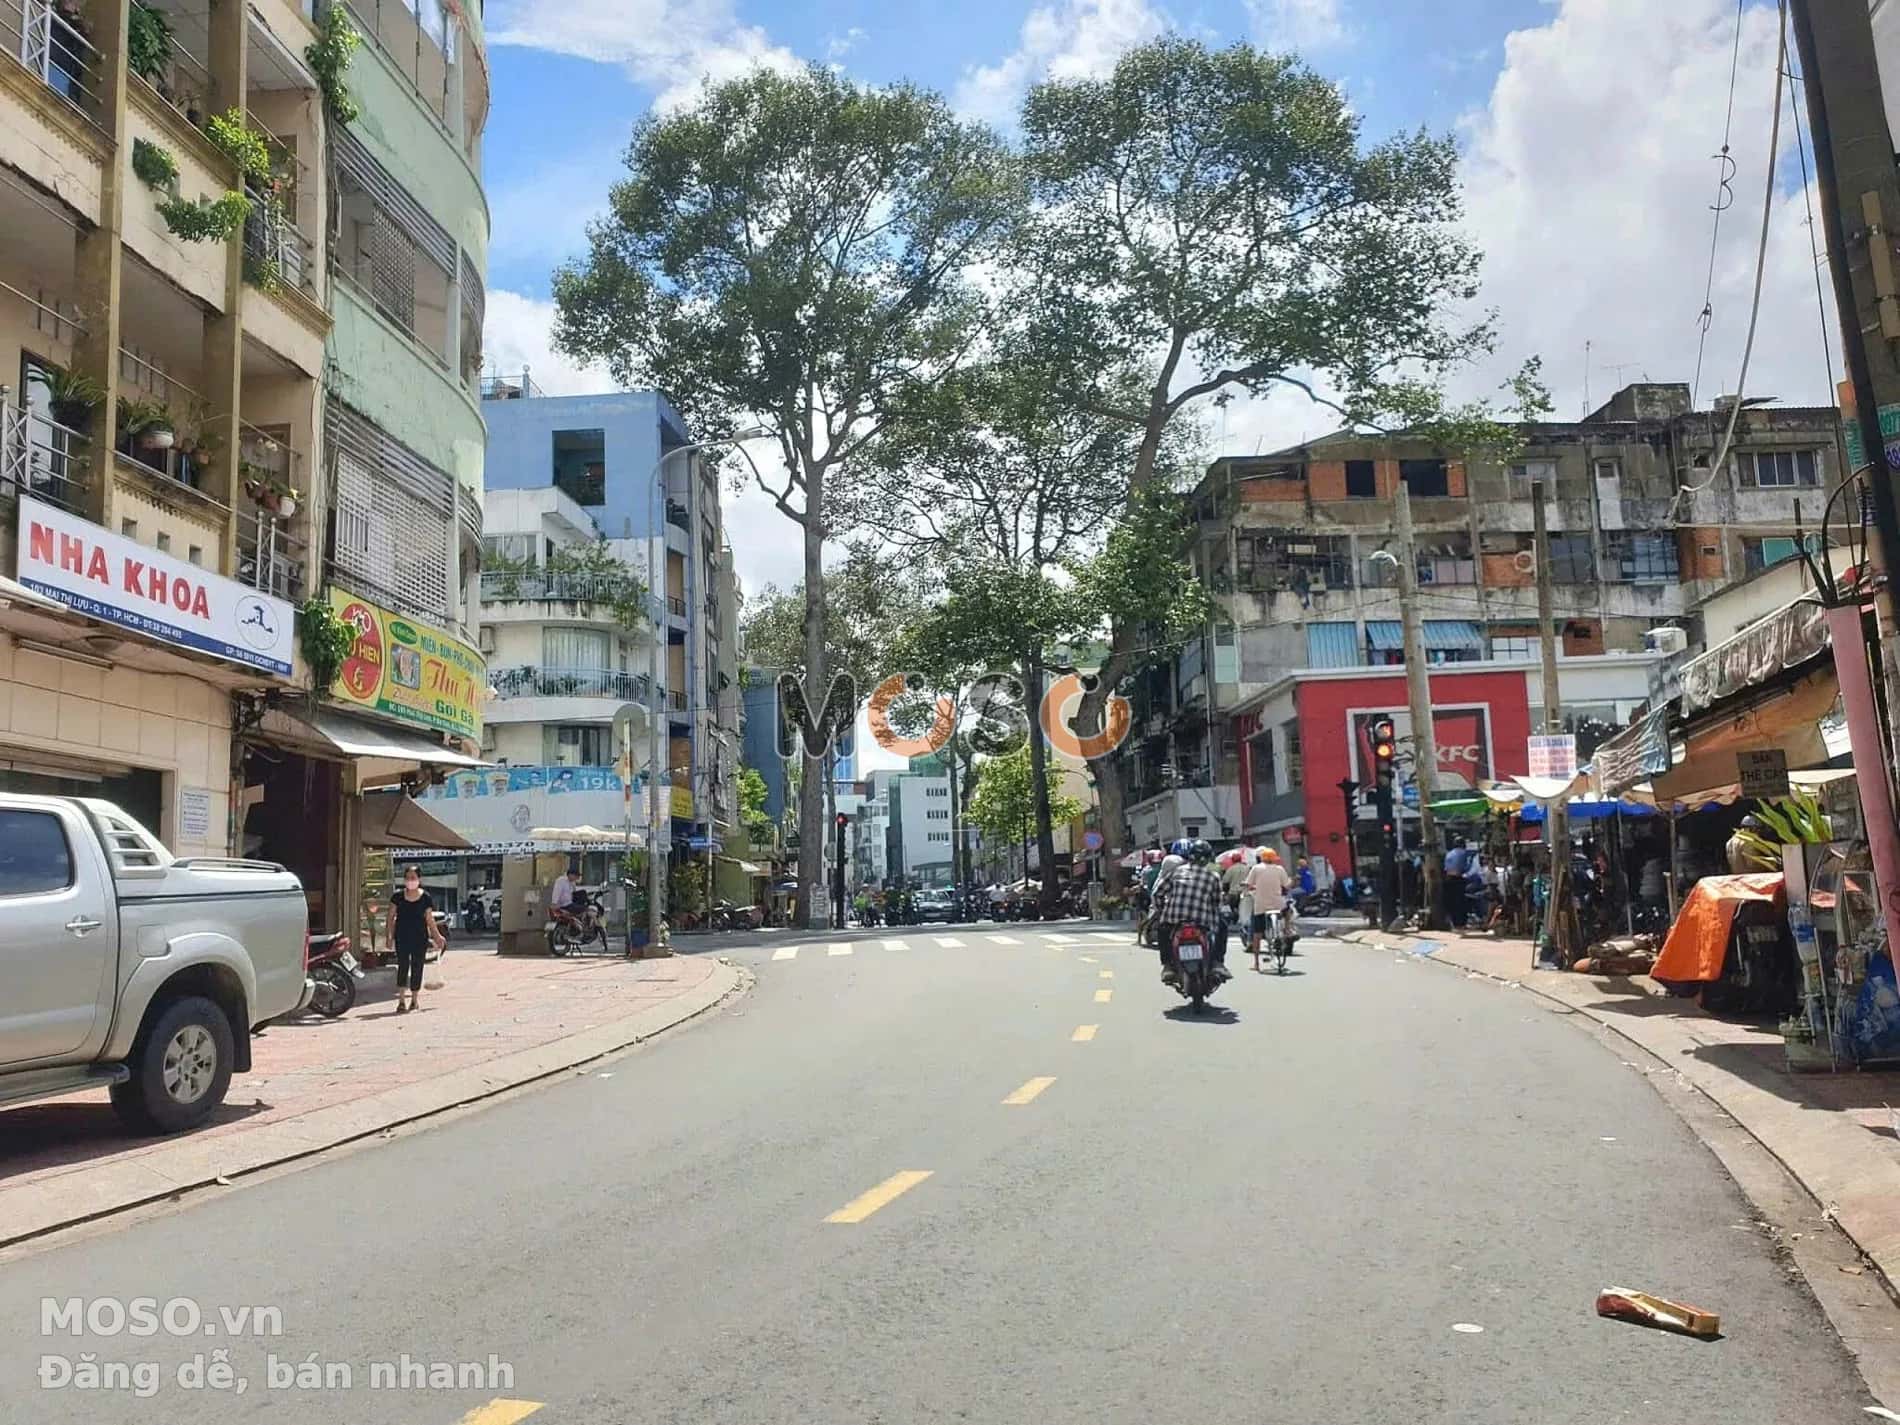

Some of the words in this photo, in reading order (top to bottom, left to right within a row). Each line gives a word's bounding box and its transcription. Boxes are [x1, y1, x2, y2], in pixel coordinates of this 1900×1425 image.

[30, 521, 110, 585] NHA
[124, 557, 210, 620] KHOA
[582, 777, 617, 790] 19k
